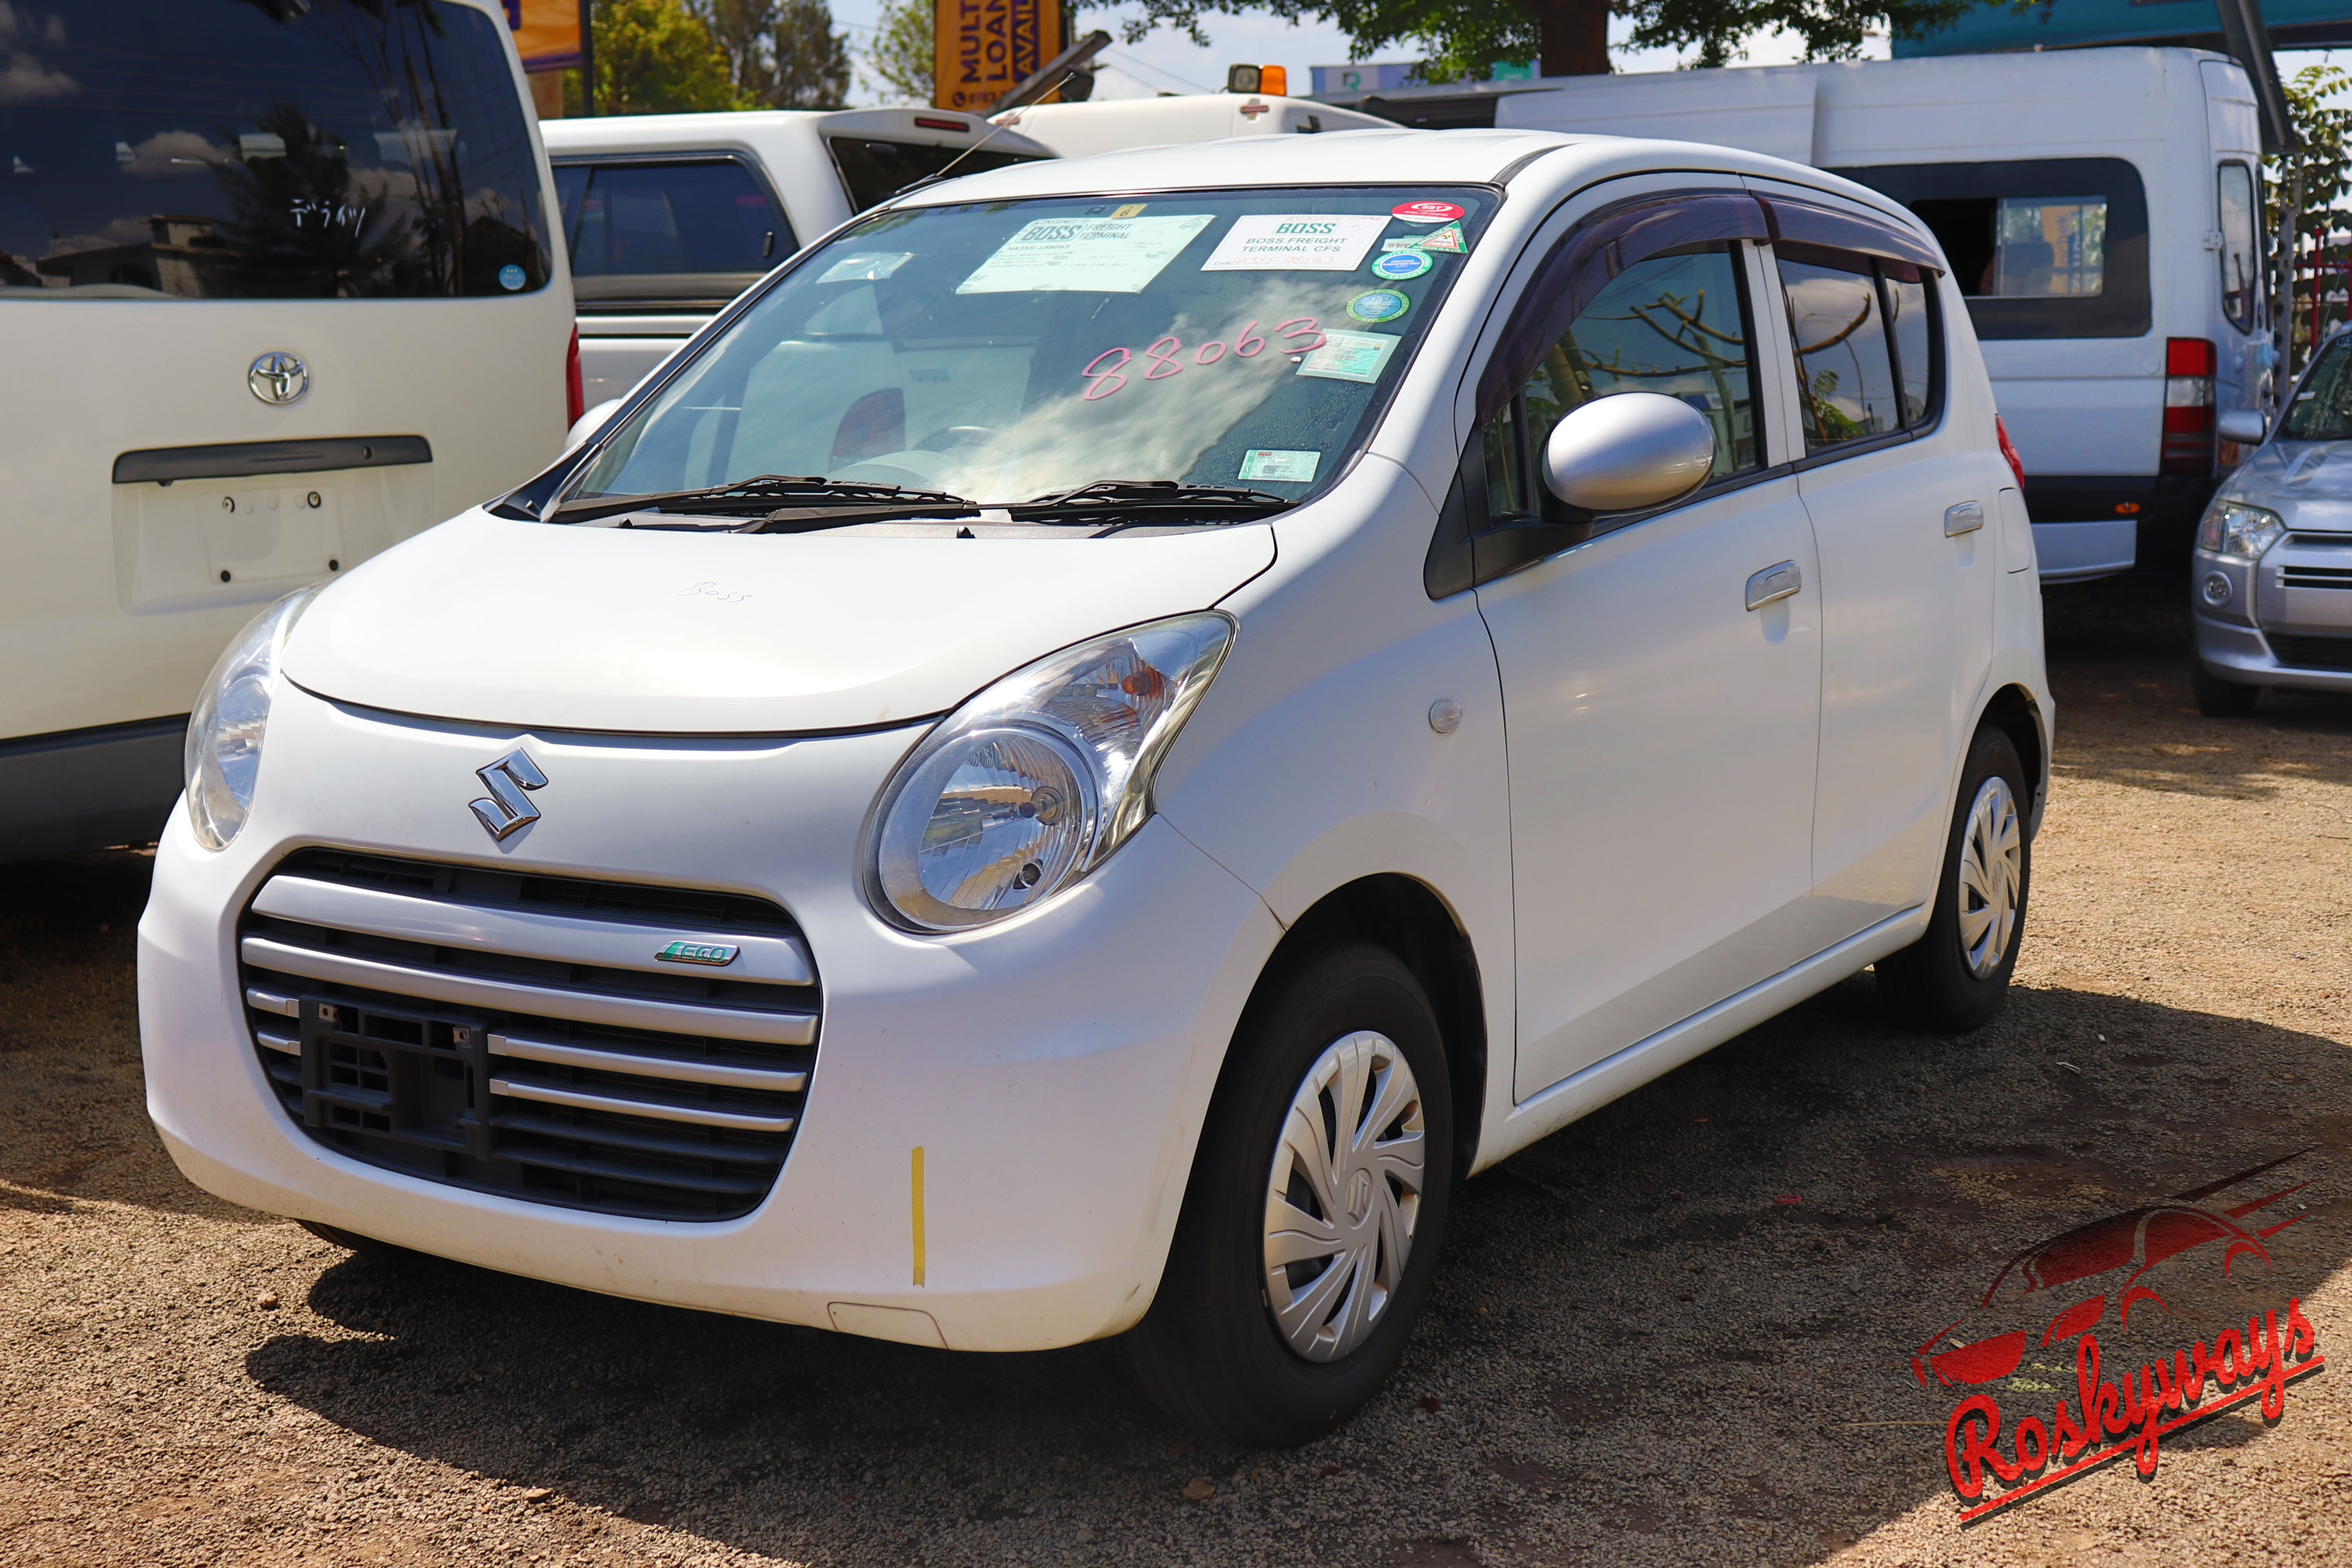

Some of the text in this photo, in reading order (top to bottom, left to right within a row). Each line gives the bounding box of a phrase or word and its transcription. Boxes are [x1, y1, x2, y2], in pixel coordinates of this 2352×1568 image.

[1020, 225, 1083, 240] BOSS
[1276, 223, 1336, 234] BOSS
[1417, 227, 1451, 245] ANALYTICAL
[1454, 228, 1463, 243] QUALITY
[1373, 250, 1431, 279] QUALITY INSPECTION SERVICES JAPAN
[1346, 289, 1410, 320] QUALITY INSPECTION SERVICES
[1082, 317, 1327, 400] 88063
[681, 945, 727, 962] ECO
